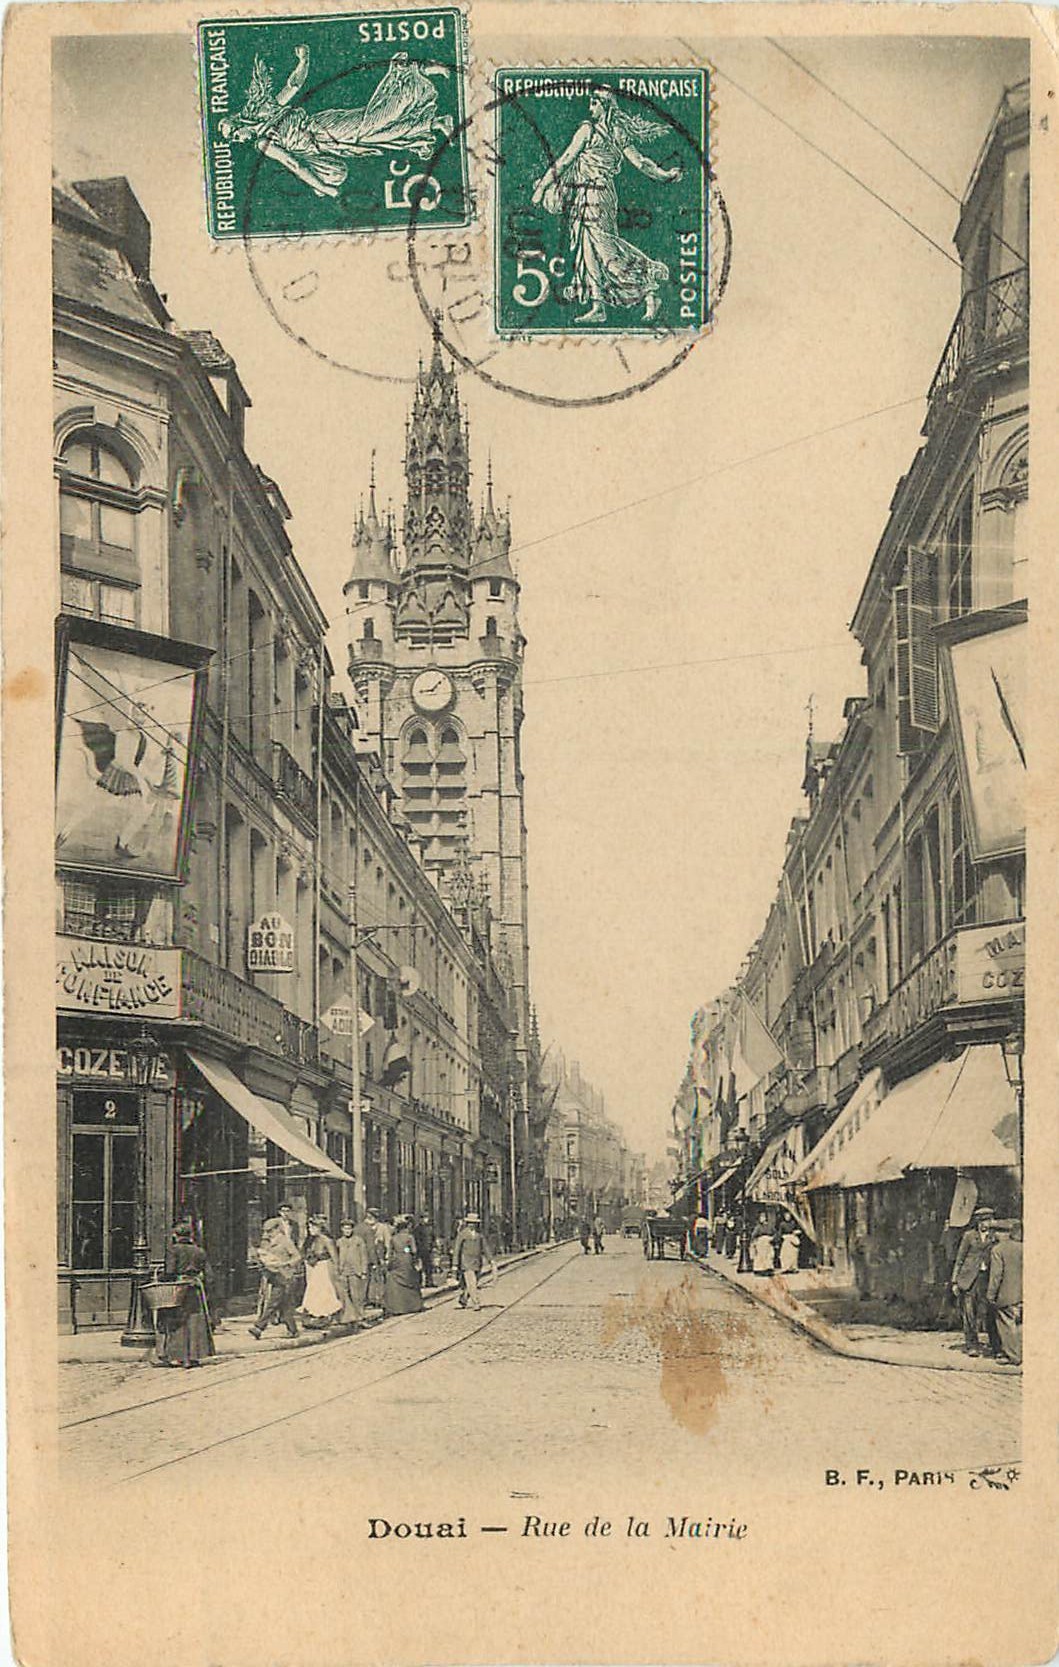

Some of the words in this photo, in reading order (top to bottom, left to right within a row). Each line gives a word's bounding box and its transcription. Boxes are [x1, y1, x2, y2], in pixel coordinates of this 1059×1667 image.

[359, 20, 445, 42] POSTES
[209, 29, 229, 113] FRANÇAISE
[619, 78, 699, 99] FRANÇAISE
[680, 232, 698, 319] POSTES
[261, 917, 280, 930] AU
[251, 931, 292, 949] BON
[57, 1047, 168, 1080] COZEE
[105, 1100, 116, 1119] 2
